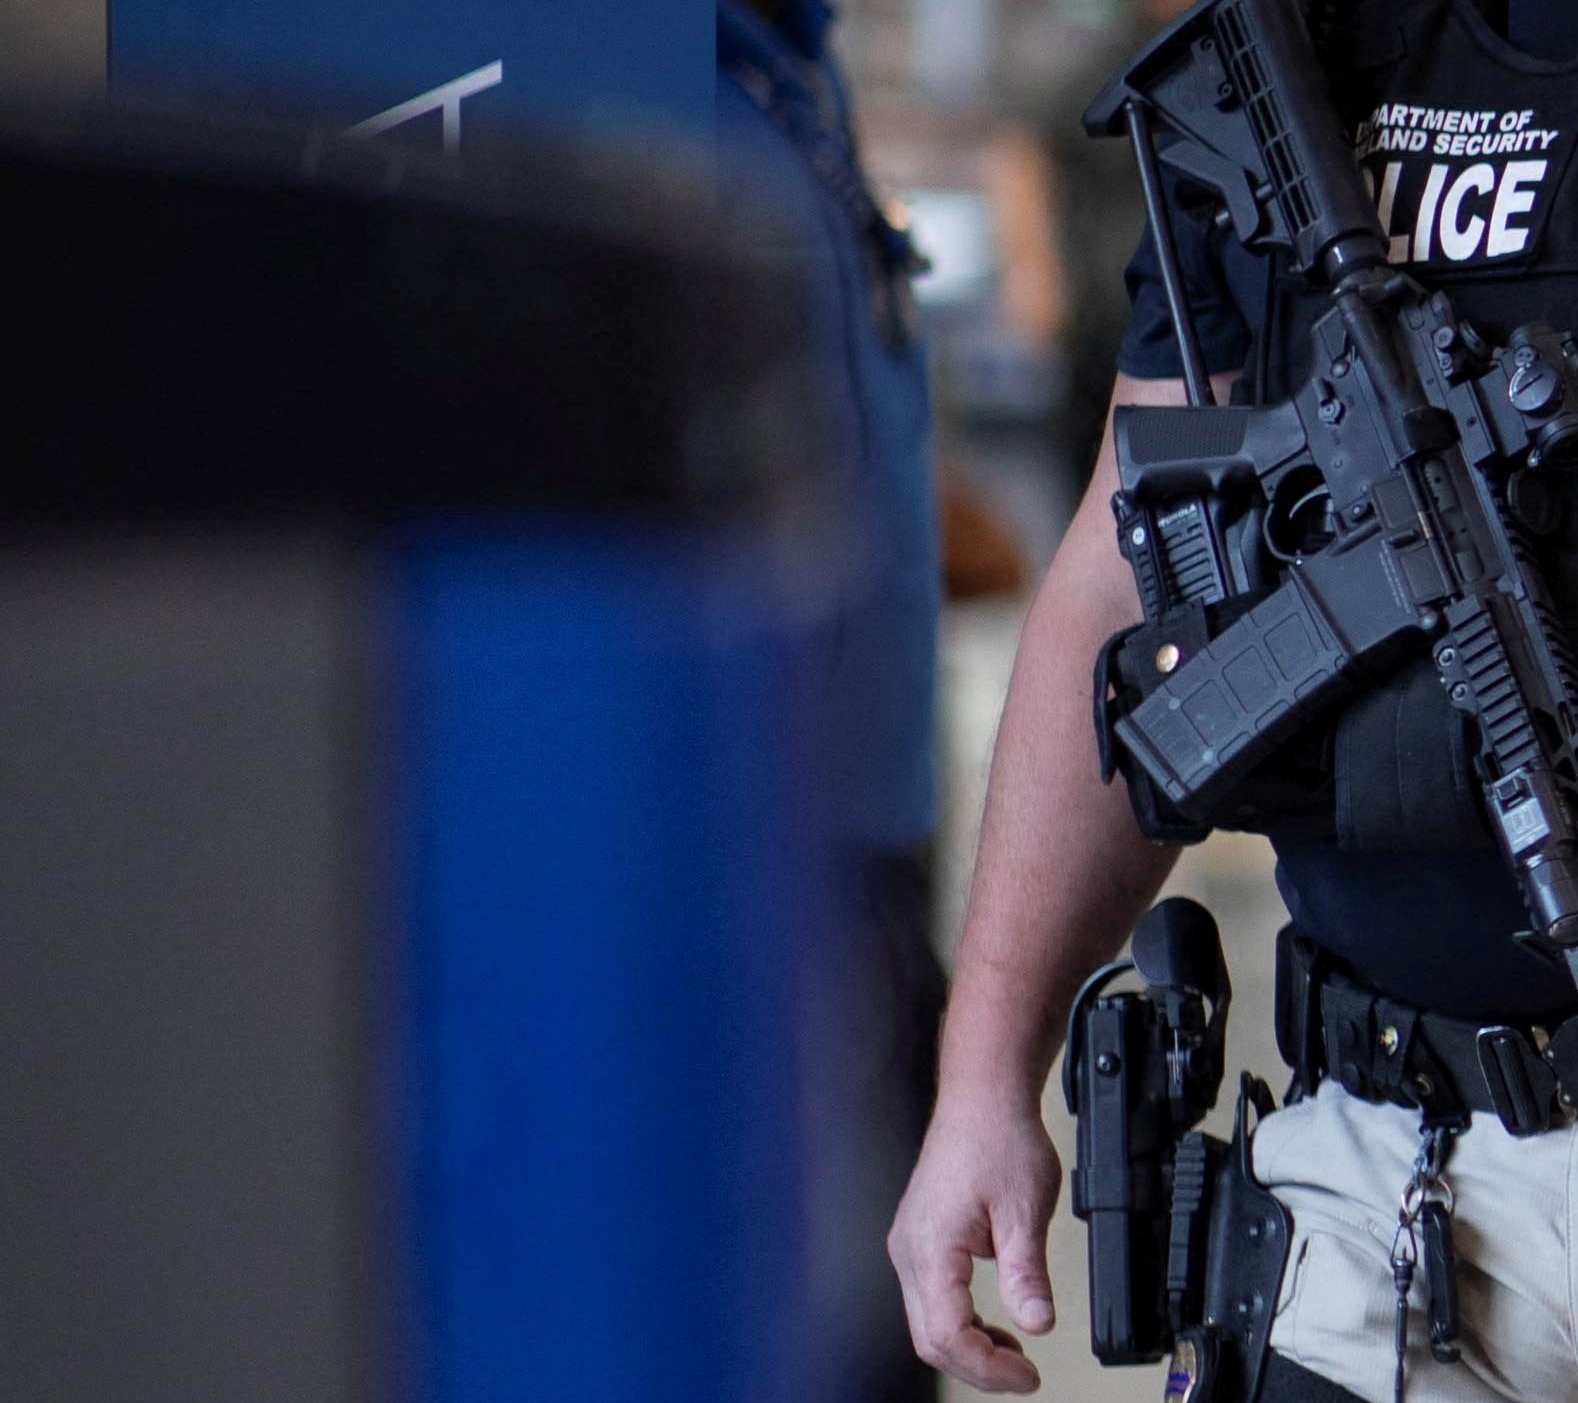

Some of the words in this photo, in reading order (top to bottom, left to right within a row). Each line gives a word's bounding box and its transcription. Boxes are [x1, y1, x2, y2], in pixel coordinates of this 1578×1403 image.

[1370, 103, 1495, 134] ARTMENT
[1500, 109, 1535, 134] OF
[1432, 130, 1559, 157] SECURITY
[1362, 159, 1549, 265] LICE
